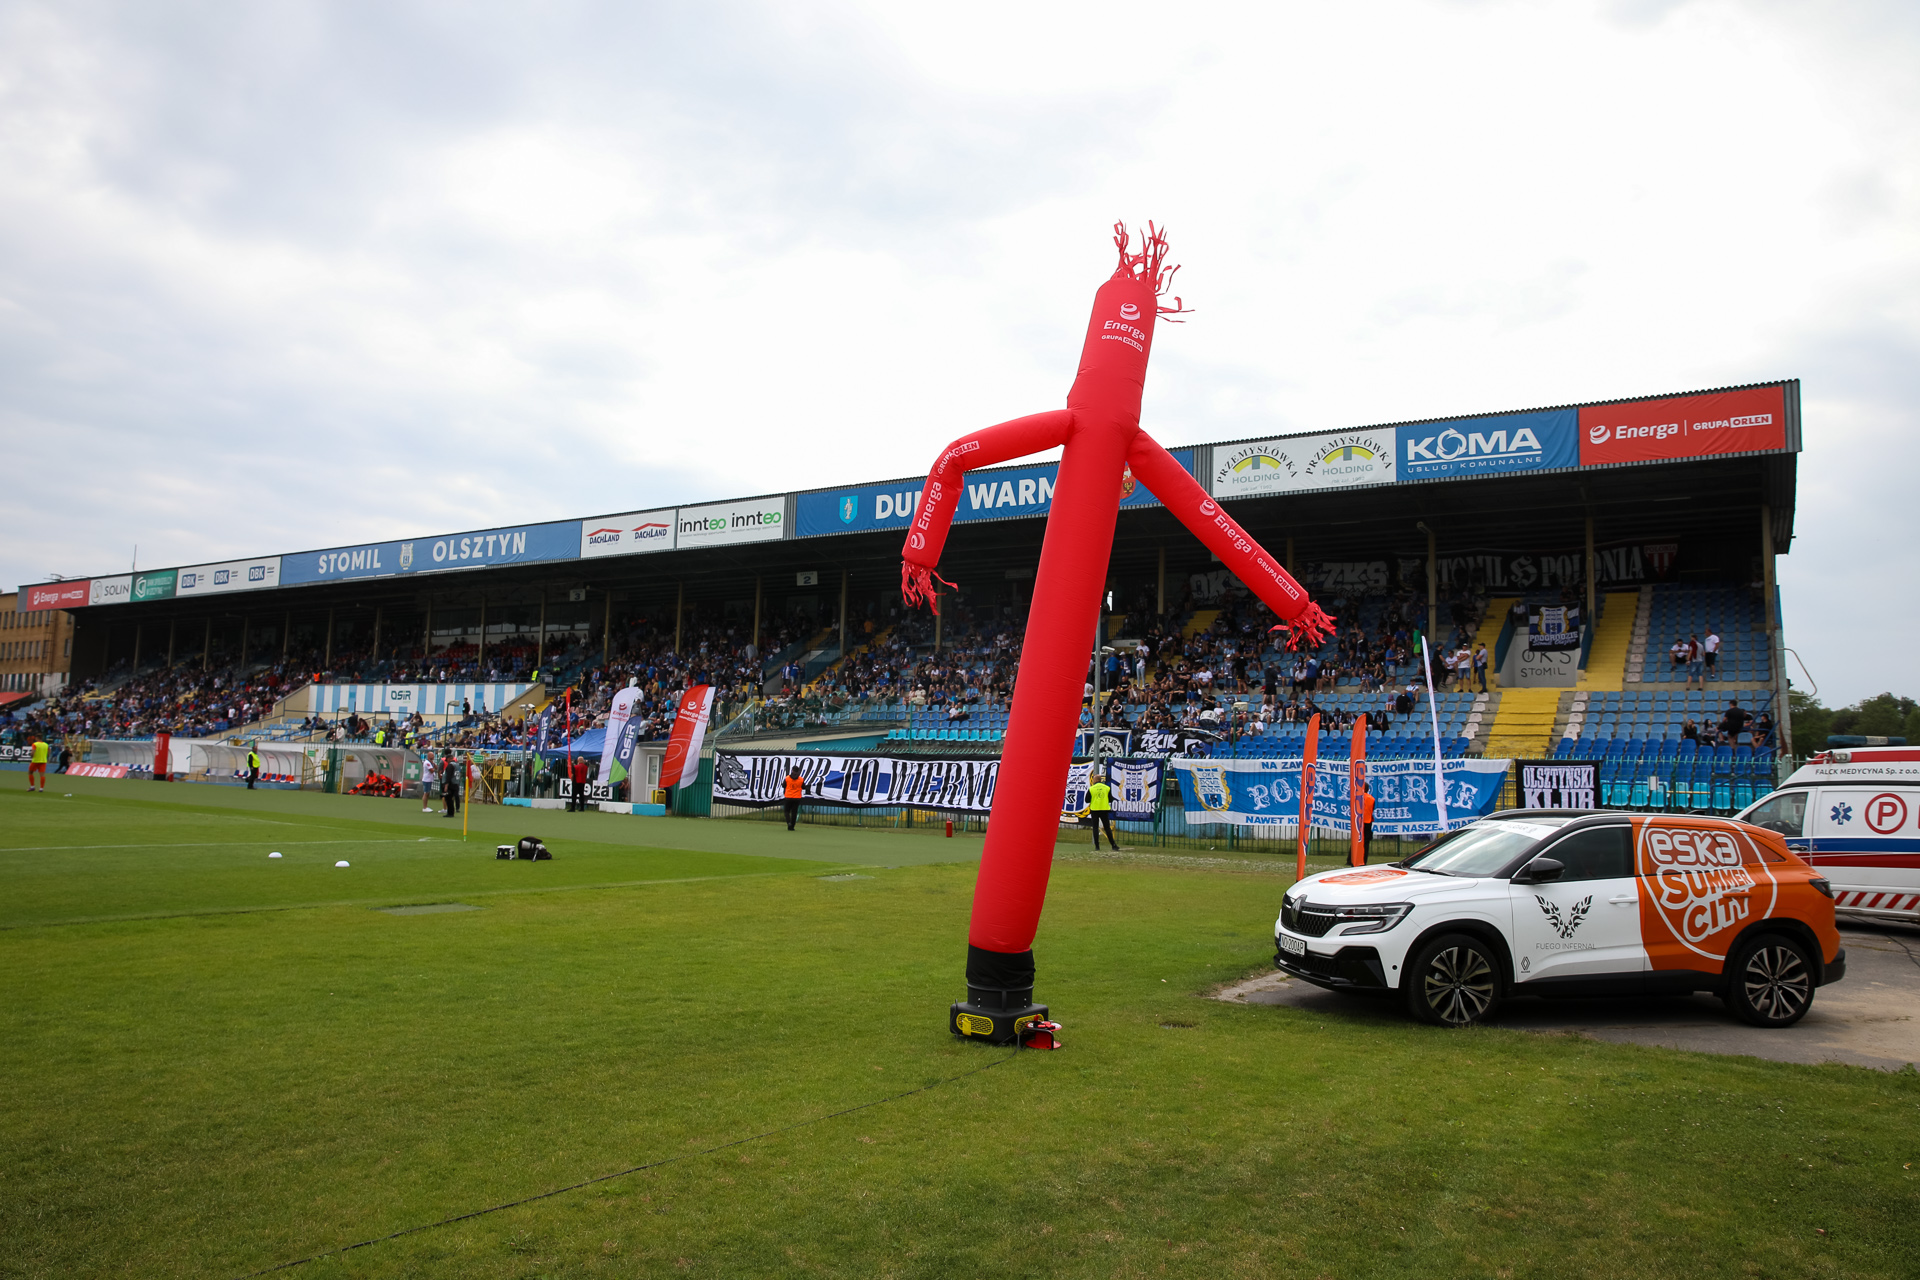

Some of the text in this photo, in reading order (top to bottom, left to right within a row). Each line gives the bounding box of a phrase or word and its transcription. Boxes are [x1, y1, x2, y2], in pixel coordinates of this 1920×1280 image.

[1103, 320, 1145, 341] Energa
[1615, 415, 1770, 440] Energa GRUPA ORLEN
[1407, 427, 1543, 461] KOMA
[937, 442, 978, 475] GRUPA ORLEN
[1305, 435, 1392, 476] PRZEMYSŁÓWKA
[1216, 445, 1298, 484] PRZEMYSŁÓWKA
[1322, 464, 1374, 476] HOLDING
[1408, 456, 1542, 473] USŁUGI KOMUNALNE
[1232, 473, 1281, 485] HOLDING
[968, 476, 1058, 510] WARM
[917, 481, 943, 530] Energa
[589, 533, 620, 545] DACHLAND
[634, 528, 668, 540] DACHLAND
[318, 549, 382, 574] STOMIL
[432, 531, 527, 562] OLSZTYN
[1214, 514, 1299, 600] Energa GRUPA ORLEN
[183, 575, 196, 587] DBK
[215, 571, 229, 584] DBK
[250, 567, 265, 580] DBK
[804, 576, 811, 584] 2
[104, 584, 129, 596] SOLIN
[40, 592, 58, 604] Energa
[1530, 631, 1578, 642] PODGRODZIE
[1521, 649, 1571, 665] OKS
[1520, 667, 1567, 678] STOMIL
[612, 710, 629, 719] Energa
[680, 708, 698, 719] Energa
[1372, 762, 1410, 774] SWOIM
[1840, 767, 1884, 775] MEDYCYNA
[1885, 767, 1897, 776] Sp.
[841, 759, 880, 804] TO
[1523, 766, 1595, 789] OLSZTYŃSKI
[1312, 800, 1337, 814] 1945
[1877, 802, 1898, 826] P
[1245, 816, 1285, 825] NAWET
[1334, 820, 1351, 831] NIE
[1651, 833, 1738, 864] eska
[1662, 869, 1752, 904] SUMMER
[1687, 896, 1748, 939] CITY
[1562, 942, 1597, 950] INFERNAL
